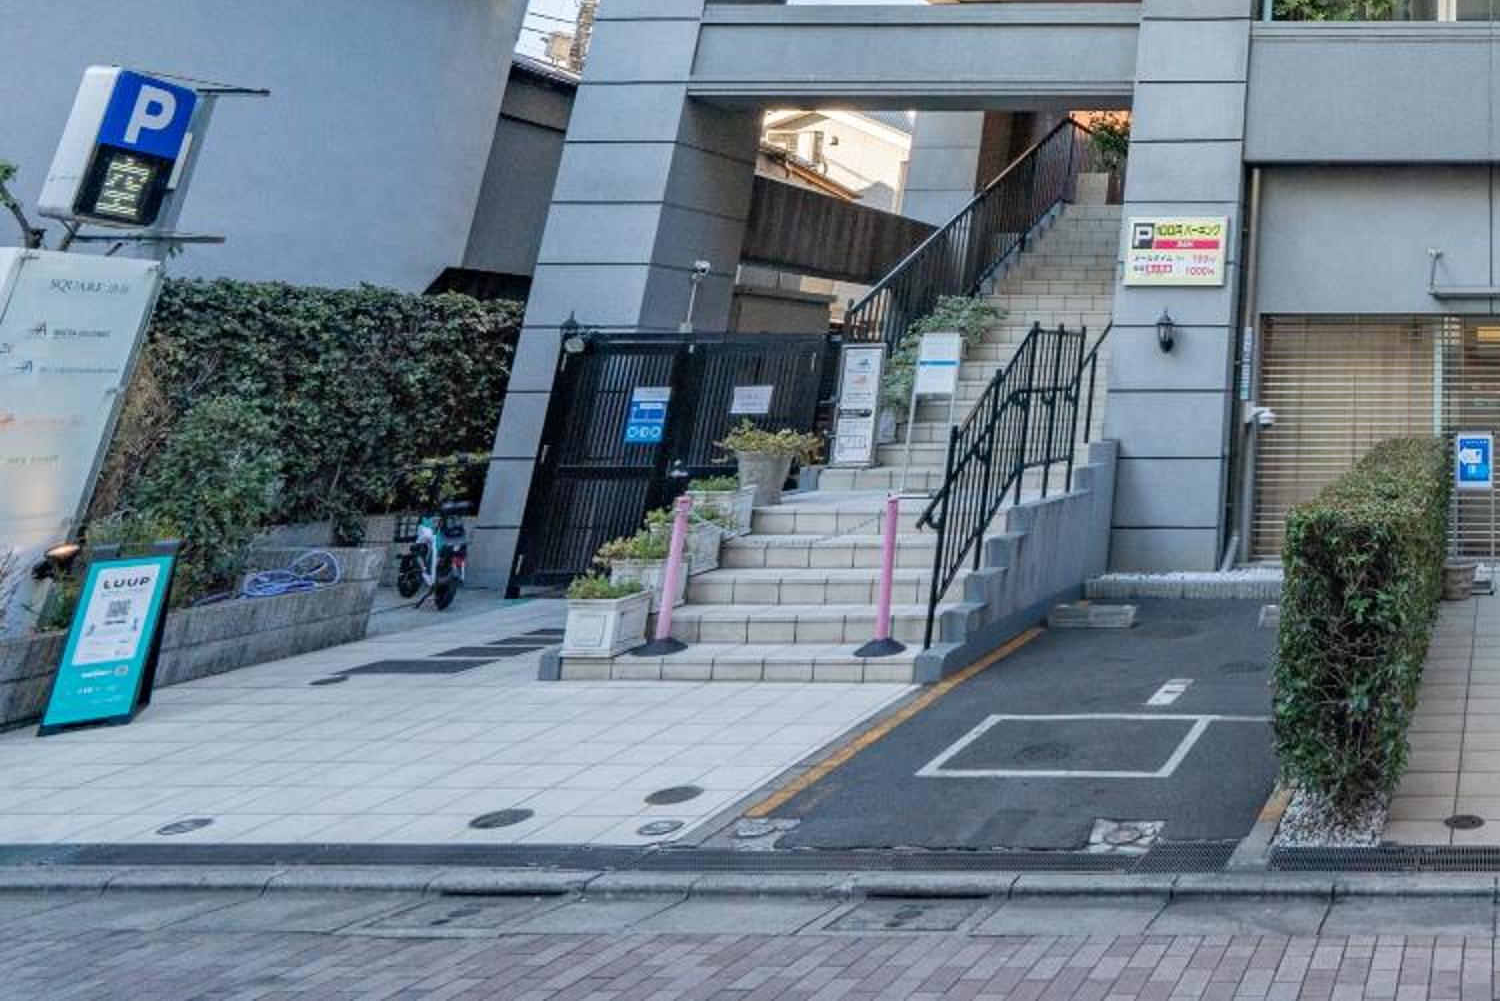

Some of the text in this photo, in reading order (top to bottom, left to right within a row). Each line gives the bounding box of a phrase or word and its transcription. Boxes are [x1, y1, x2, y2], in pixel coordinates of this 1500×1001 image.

[124, 84, 177, 144] P
[1134, 226, 1153, 247] P
[103, 576, 152, 590] LUUP
